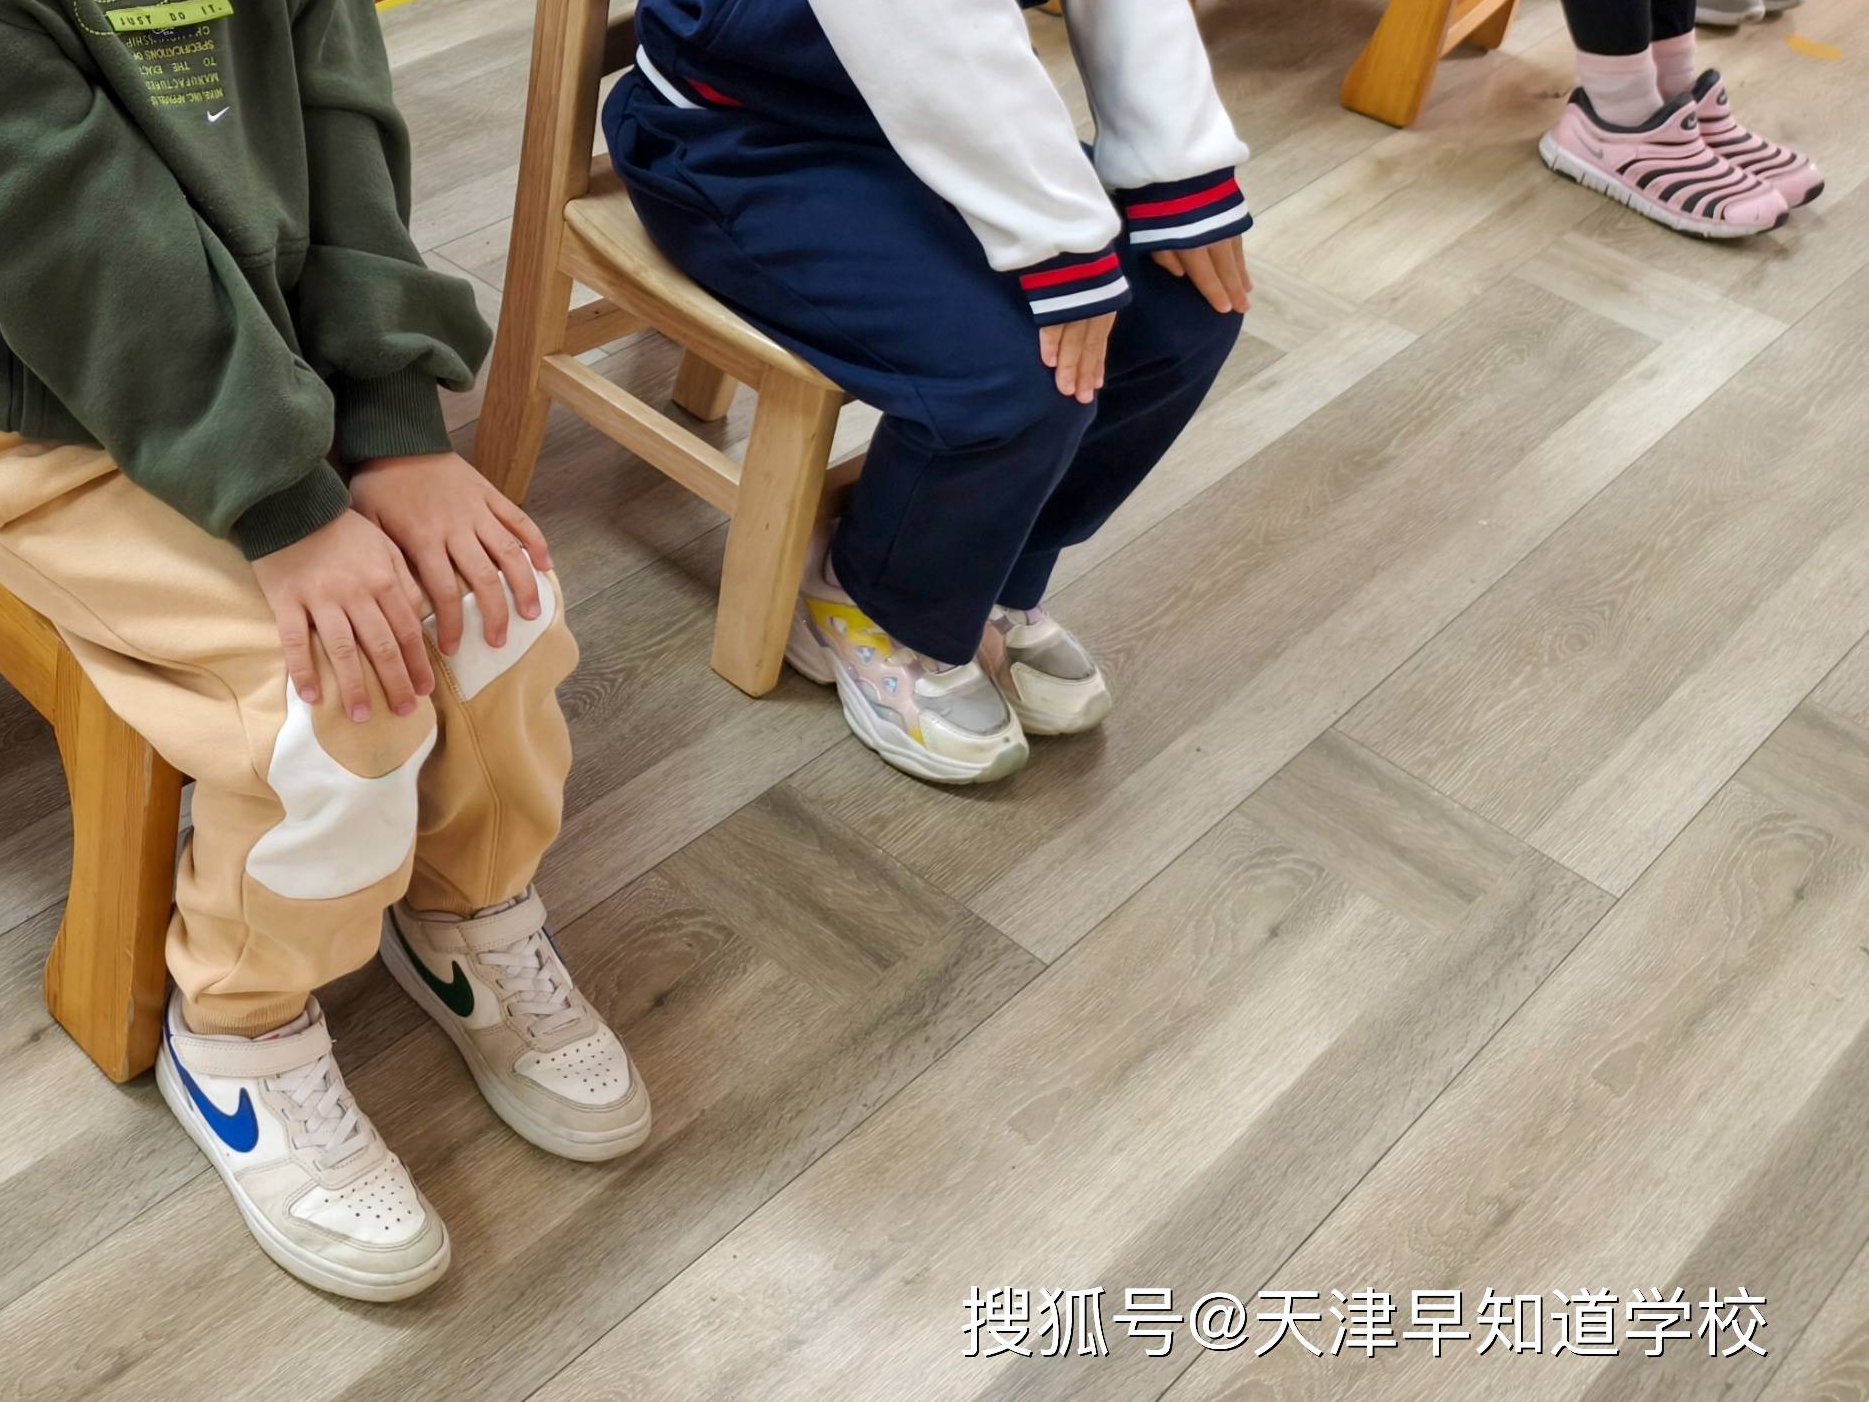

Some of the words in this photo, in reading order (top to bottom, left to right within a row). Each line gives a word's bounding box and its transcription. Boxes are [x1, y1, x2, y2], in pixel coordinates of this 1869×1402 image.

[119, 14, 152, 26] JUST
[169, 11, 186, 22] DO
[201, 4, 223, 16] IT.
[170, 61, 191, 72] THE
[203, 56, 217, 67] TO
